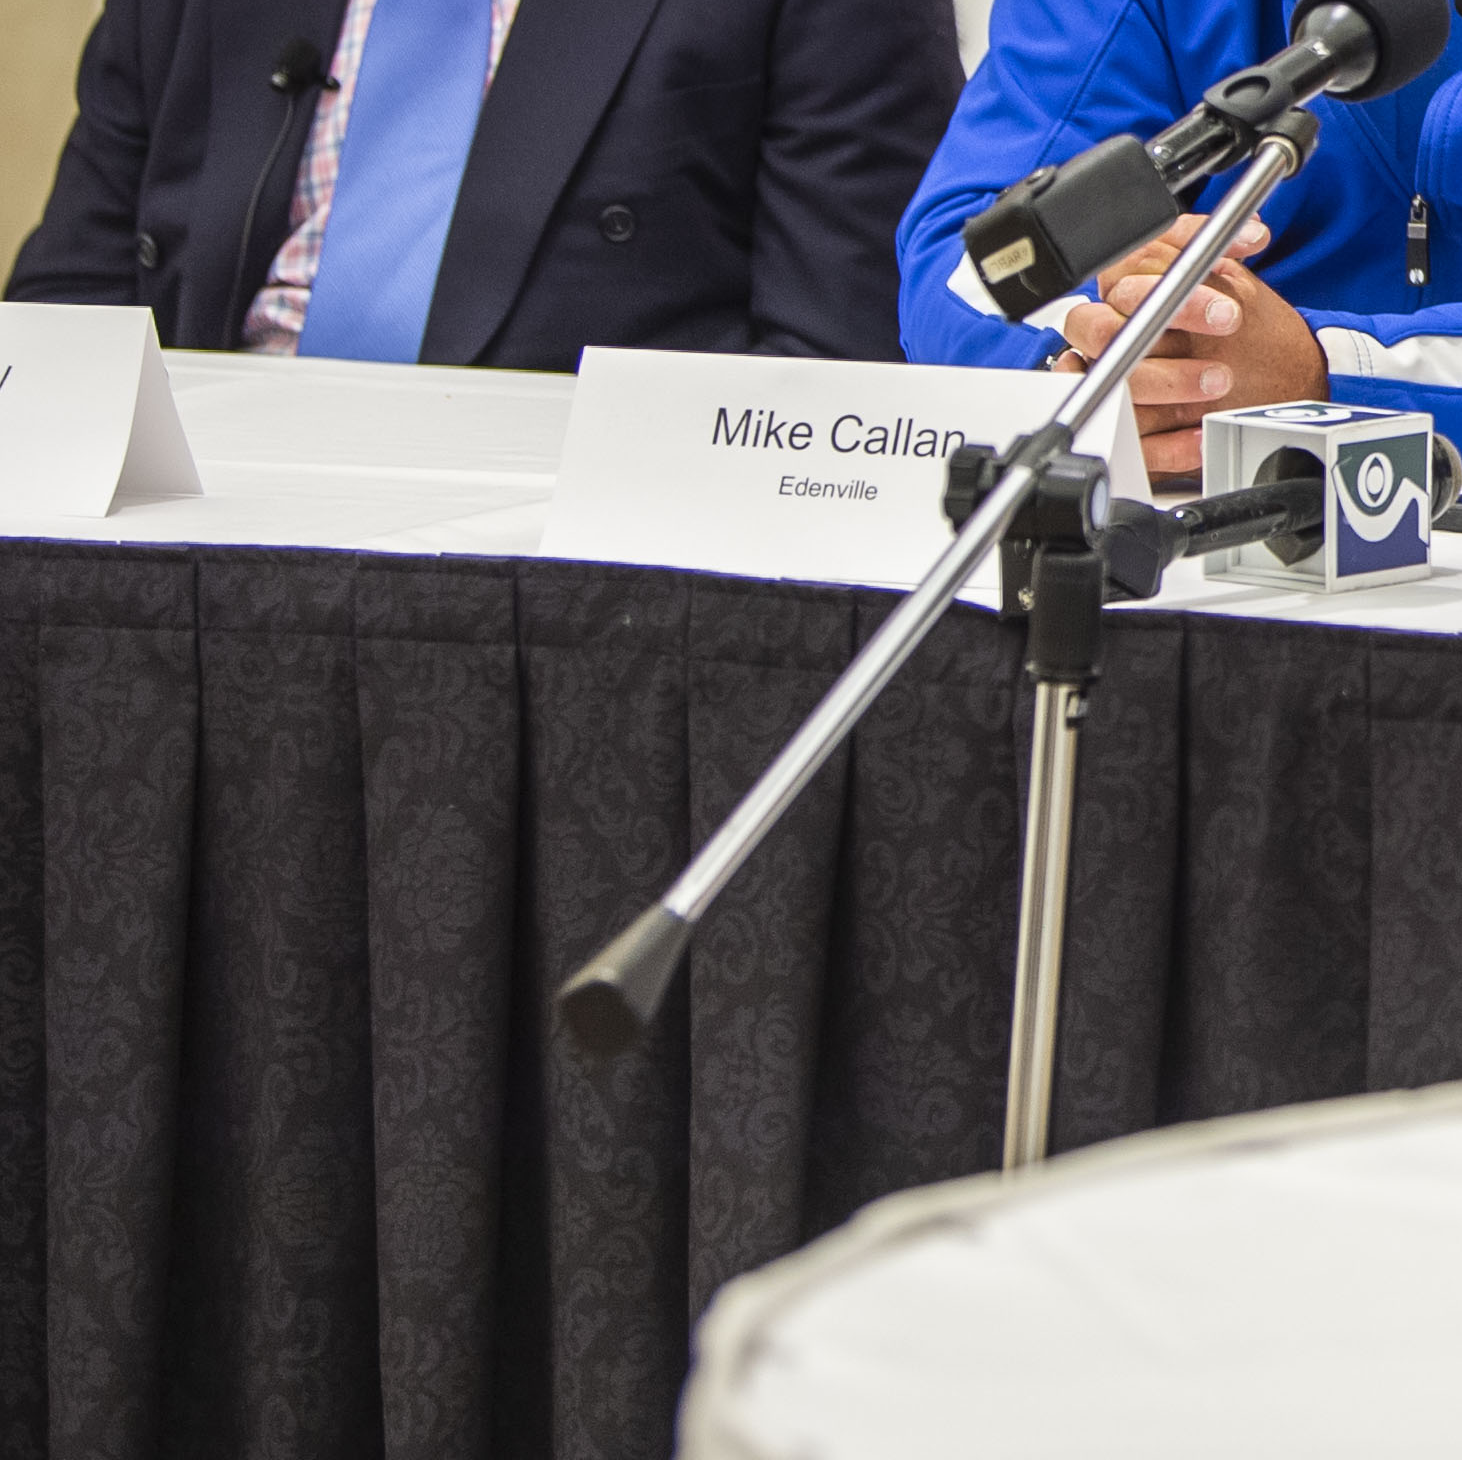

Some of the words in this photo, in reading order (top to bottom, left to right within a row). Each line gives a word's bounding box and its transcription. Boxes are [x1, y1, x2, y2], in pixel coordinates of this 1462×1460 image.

[711, 406, 813, 451] Mike
[830, 414, 966, 459] Callan
[778, 475, 878, 501] Edenville
